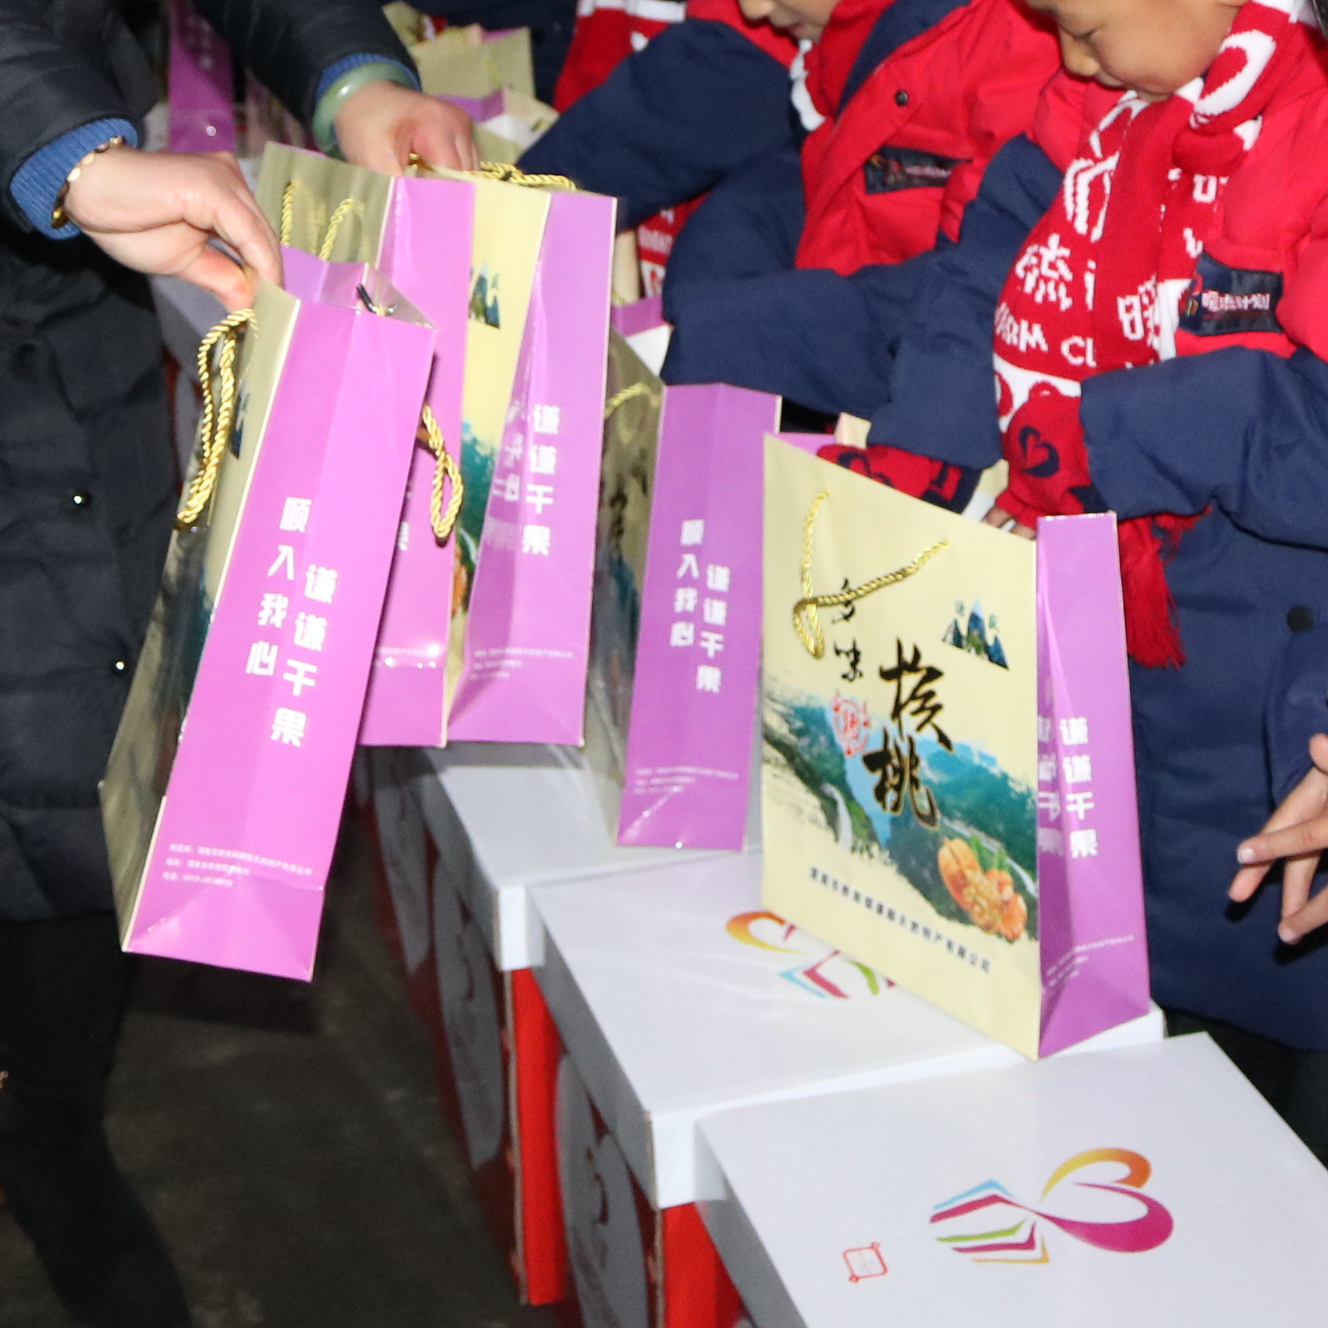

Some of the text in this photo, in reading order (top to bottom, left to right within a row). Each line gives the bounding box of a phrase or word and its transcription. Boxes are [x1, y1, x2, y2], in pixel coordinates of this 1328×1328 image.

[244, 495, 313, 677] 顺入我心
[269, 563, 338, 748] 谦谦干果
